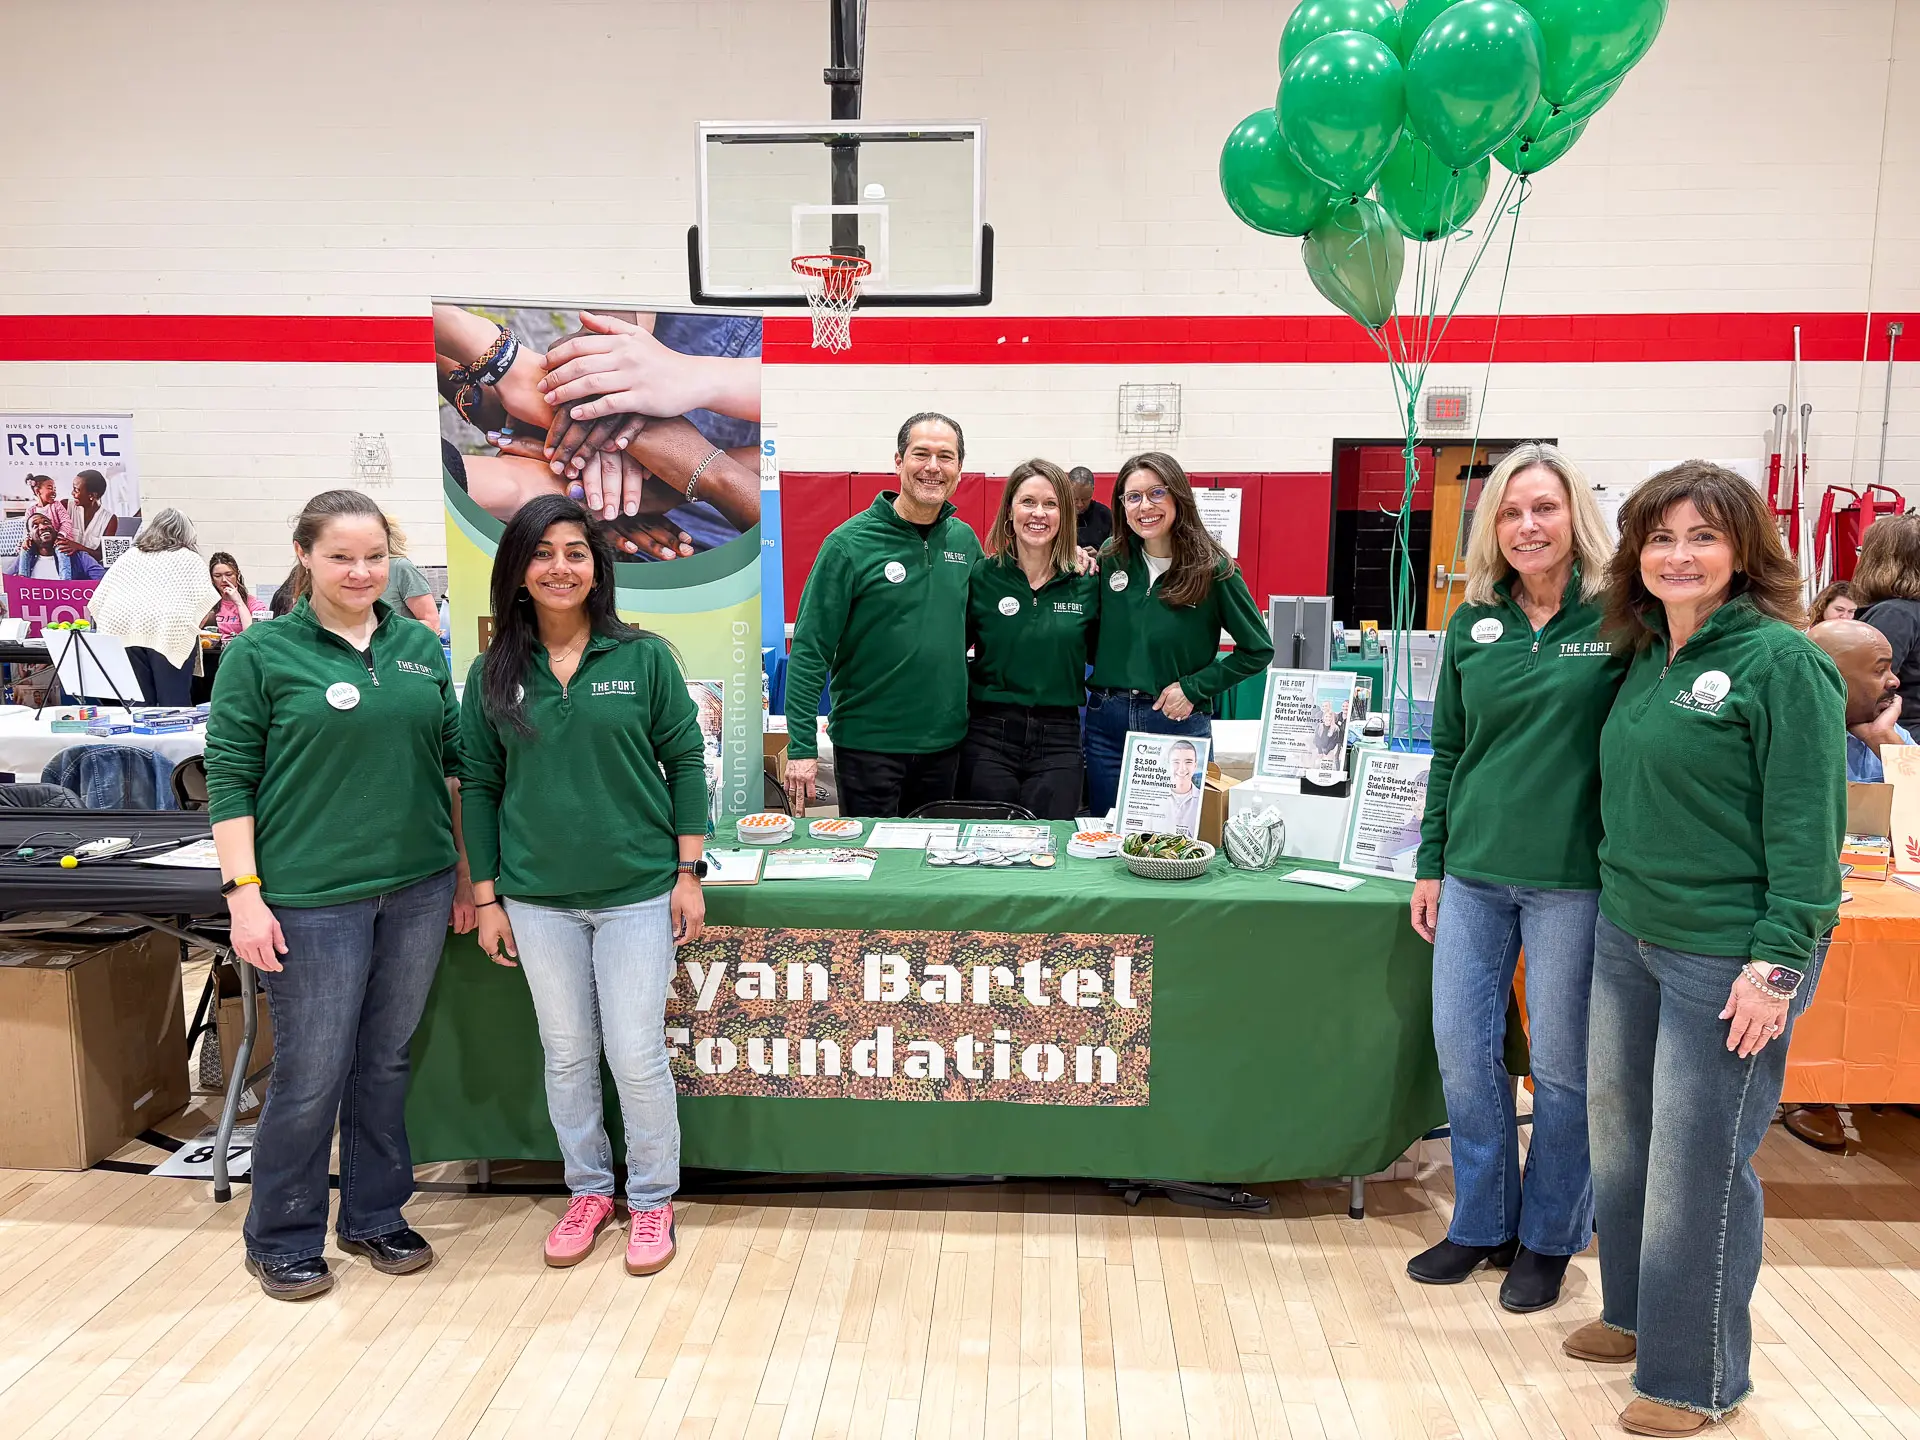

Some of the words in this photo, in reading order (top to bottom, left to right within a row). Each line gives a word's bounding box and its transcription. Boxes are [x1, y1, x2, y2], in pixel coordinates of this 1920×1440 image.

[944, 551, 954, 560] THE
[955, 552, 966, 560] FORT
[20, 588, 94, 600] REDISCO
[1053, 602, 1066, 610] THE
[1068, 603, 1083, 611] FORT
[1560, 643, 1580, 653] THE
[1584, 642, 1612, 652] FORT
[396, 660, 414, 670] THE
[415, 663, 433, 675] FORT
[591, 682, 610, 692] THE
[612, 681, 635, 690] FORT
[1704, 680, 1719, 692] Val
[1134, 765, 1167, 775] Scholarship
[1384, 762, 1399, 770] FORT
[1141, 780, 1176, 788] Nominations
[1387, 777, 1406, 785] Stand
[1366, 790, 1390, 799] Change
[1391, 793, 1418, 802] Happen.
[863, 954, 1138, 1008] Bartel
